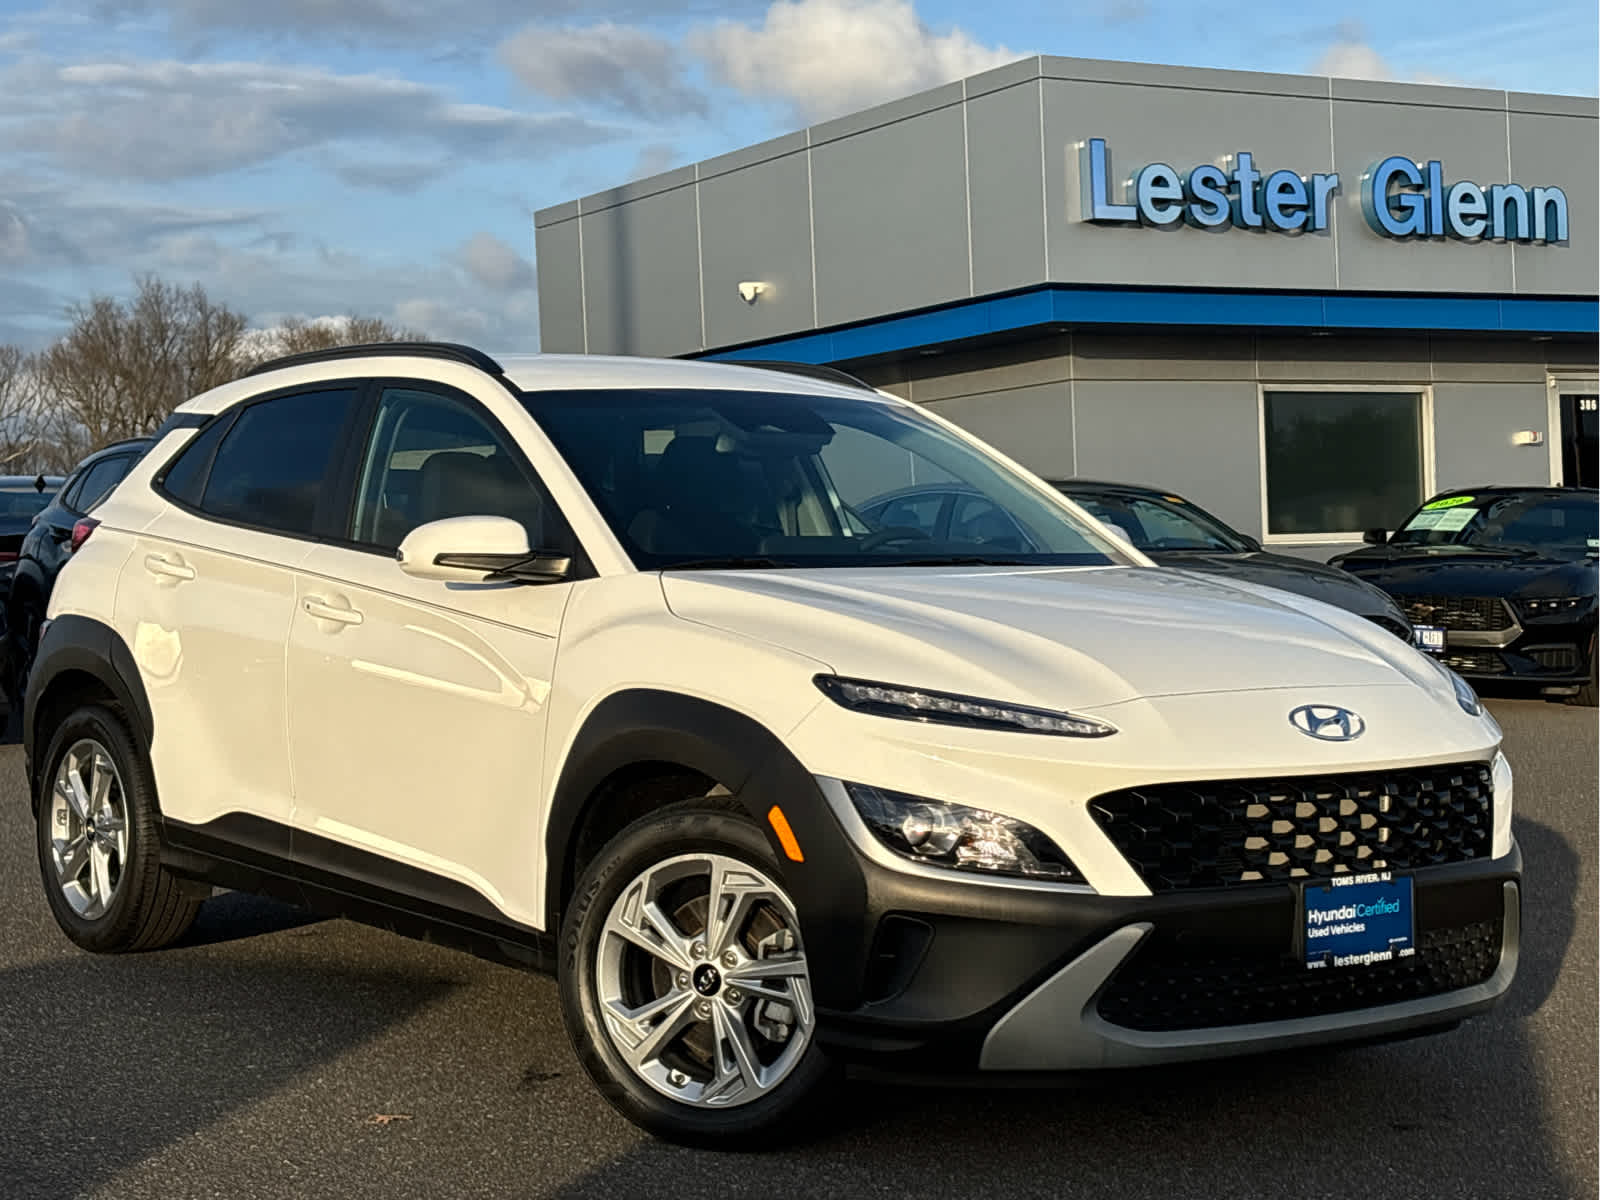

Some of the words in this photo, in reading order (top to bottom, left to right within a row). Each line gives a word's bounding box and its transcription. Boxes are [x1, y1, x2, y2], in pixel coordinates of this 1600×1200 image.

[1082, 138, 1339, 231] Lester
[1363, 156, 1569, 242] Glenn
[1331, 877, 1354, 887] TOMS
[1381, 872, 1391, 882] NJ
[1308, 927, 1329, 938] Used
[1330, 922, 1366, 936] Vehicles
[1334, 951, 1393, 967] lesterglenn
